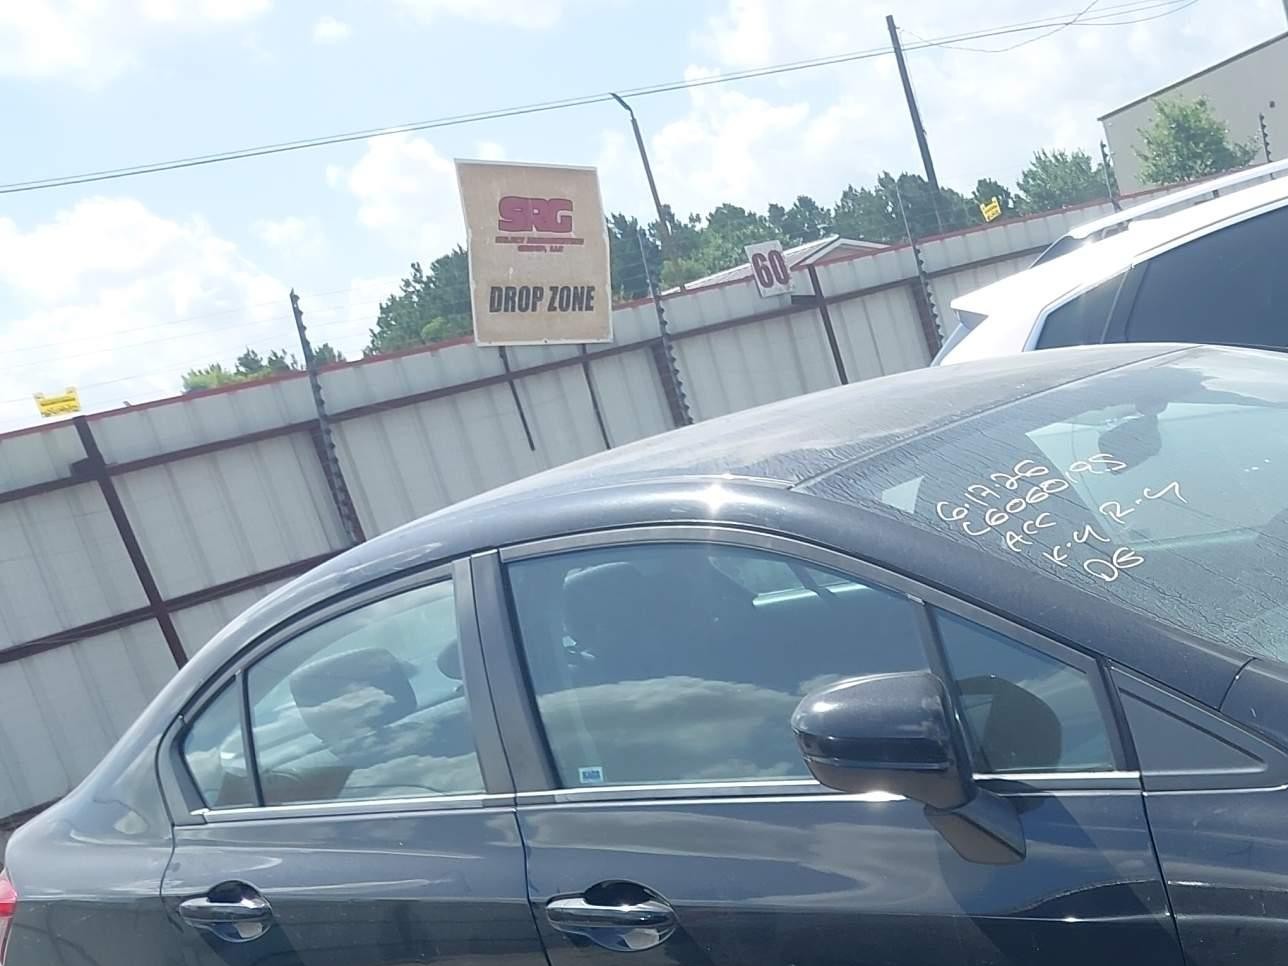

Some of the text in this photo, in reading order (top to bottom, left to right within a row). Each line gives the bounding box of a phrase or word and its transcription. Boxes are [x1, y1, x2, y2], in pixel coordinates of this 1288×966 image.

[498, 196, 574, 233] SRG
[751, 249, 790, 288] 60
[489, 286, 596, 312] DROP ZONE
